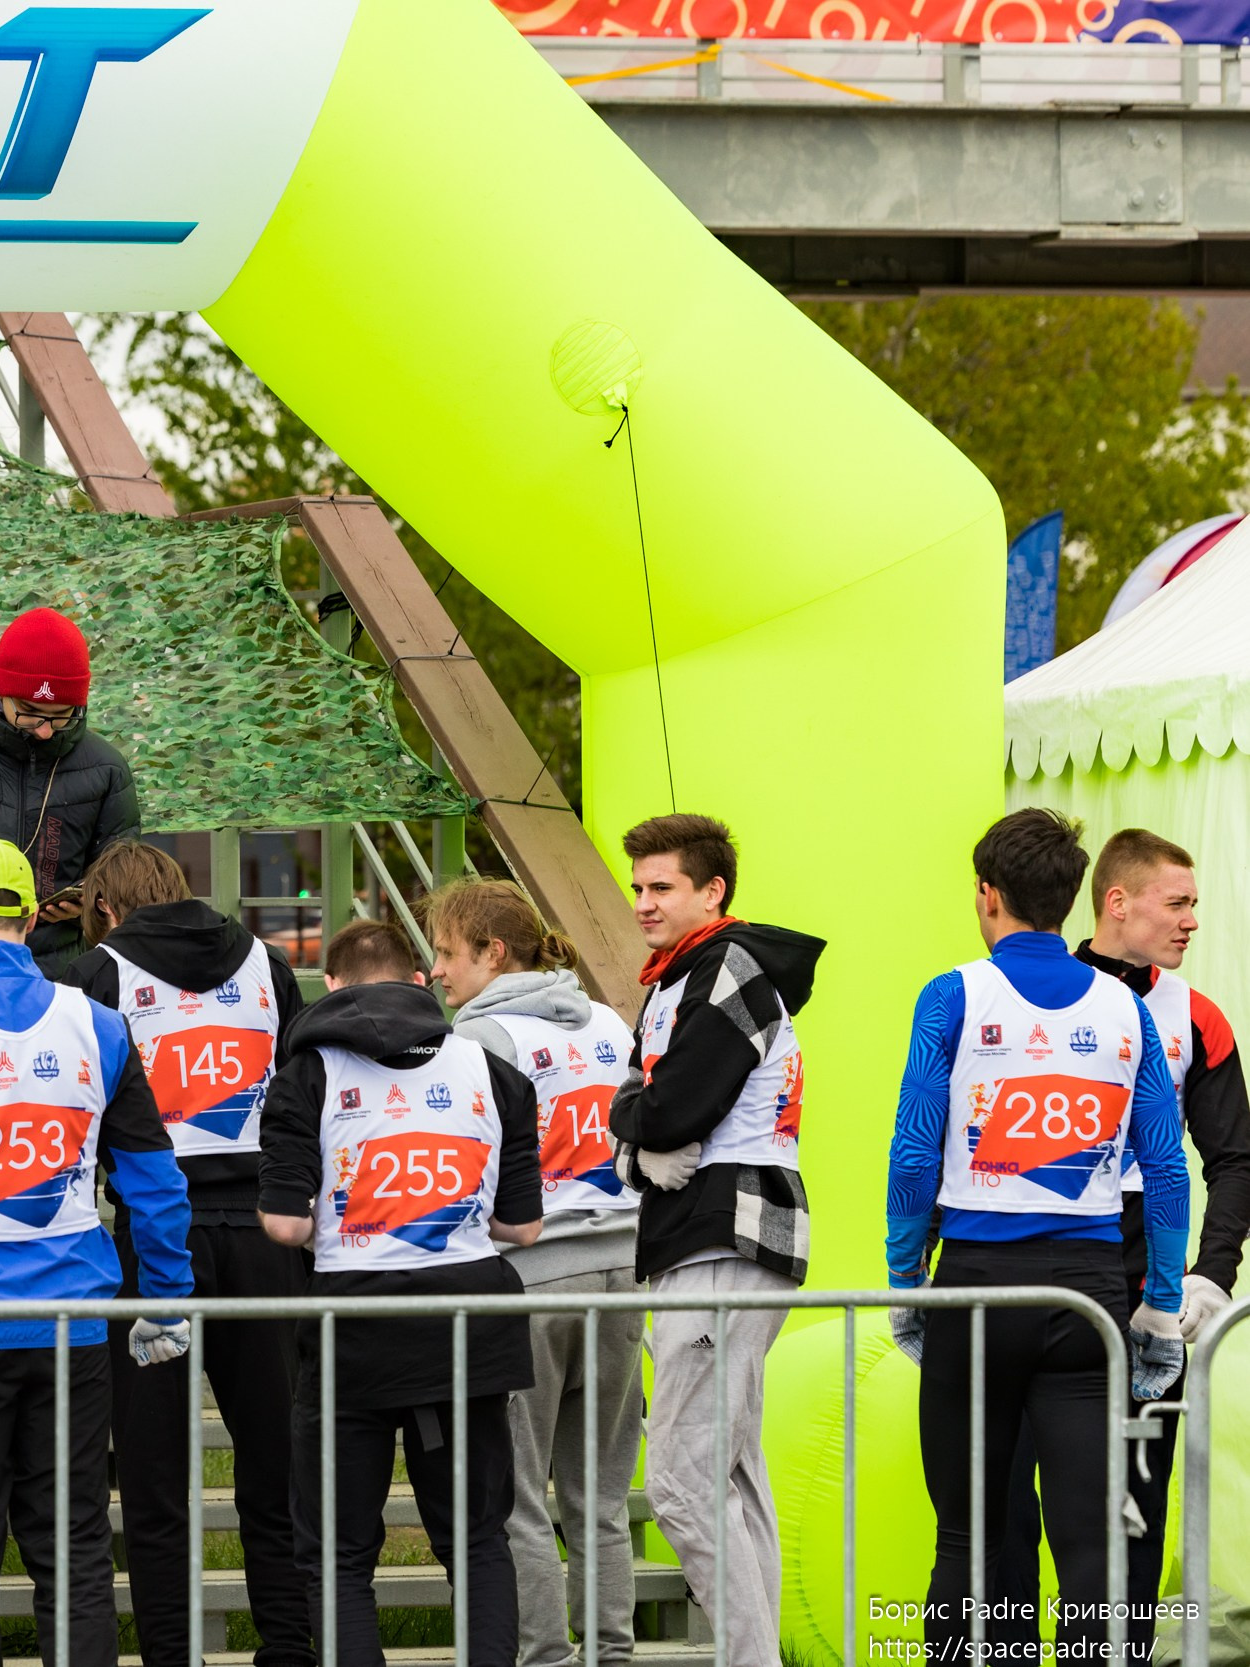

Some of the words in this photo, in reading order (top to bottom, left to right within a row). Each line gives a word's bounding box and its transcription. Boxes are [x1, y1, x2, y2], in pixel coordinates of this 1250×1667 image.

[42, 815, 63, 901] MADSHU
[172, 1041, 243, 1088] 145
[566, 1101, 607, 1147] 14
[1005, 1091, 1101, 1141] 283
[370, 1149, 462, 1199] 255
[972, 1172, 1000, 1187] ГТО
[341, 1234, 370, 1248] ГТО
